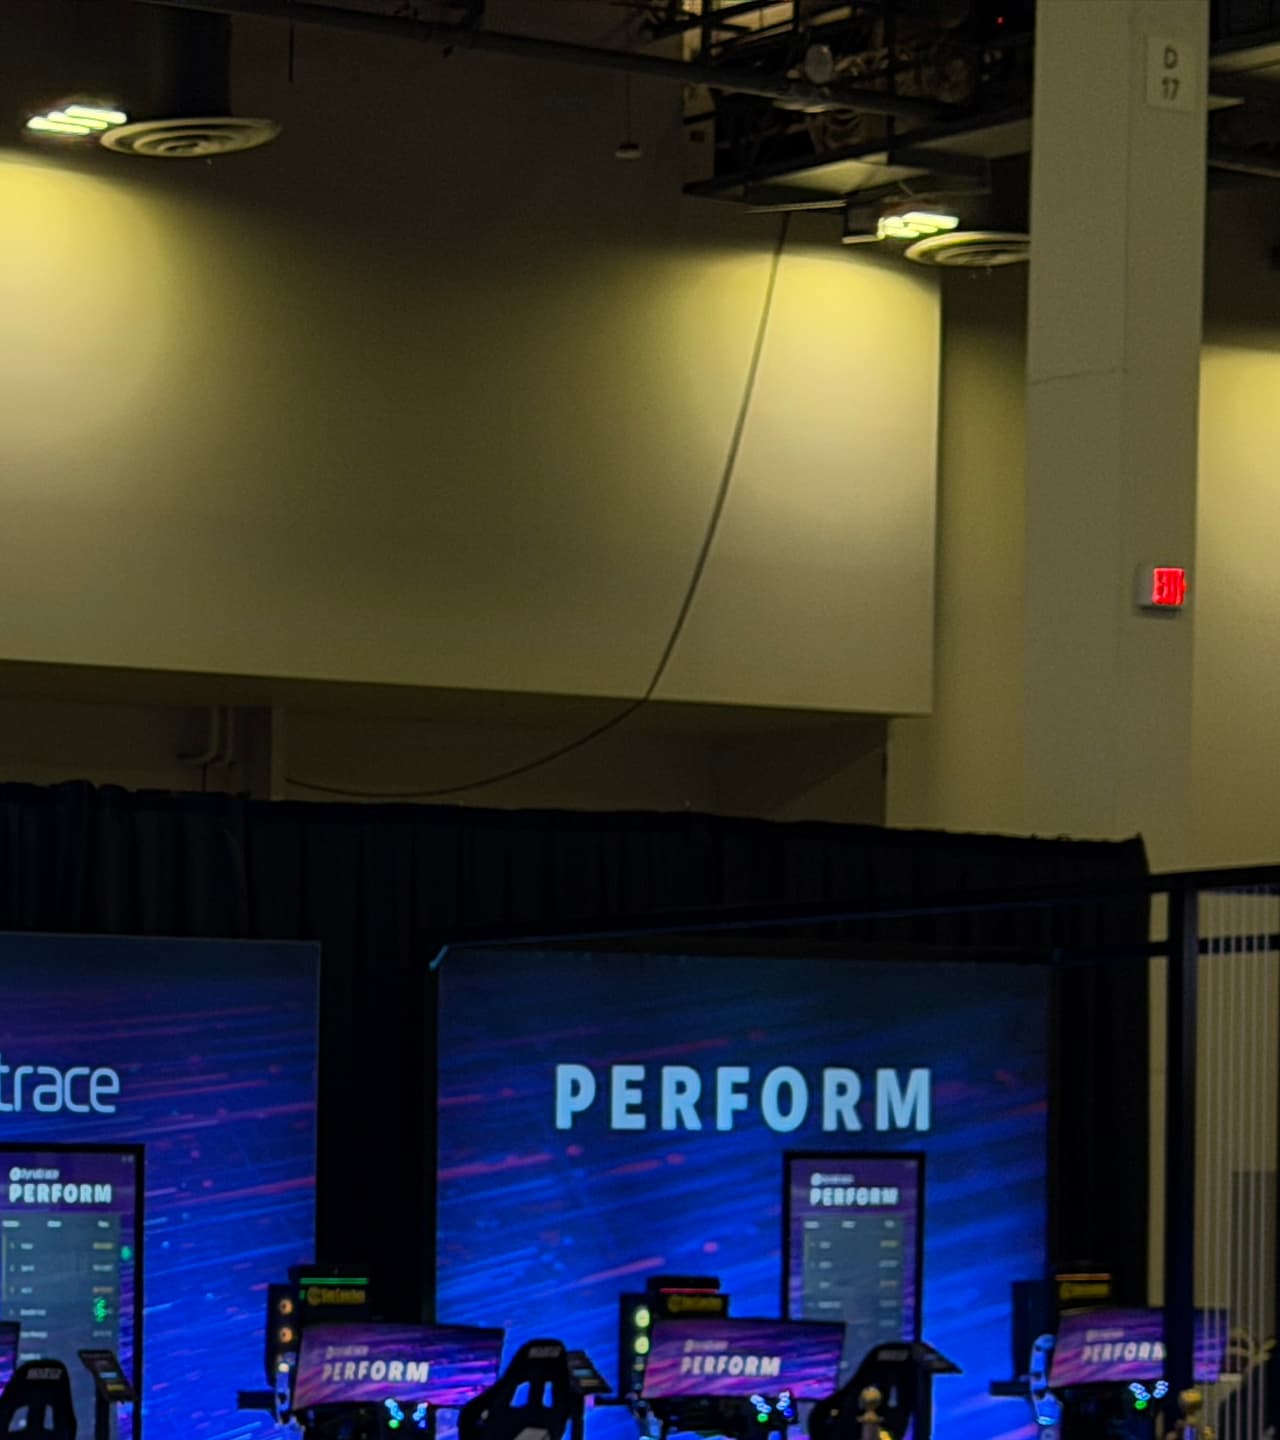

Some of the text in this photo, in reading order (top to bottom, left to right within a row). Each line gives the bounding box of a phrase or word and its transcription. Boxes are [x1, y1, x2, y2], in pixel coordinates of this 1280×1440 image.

[1164, 45, 1178, 70] D
[1161, 76, 1180, 101] 17
[555, 1063, 932, 1133] PERFORM
[9, 1183, 112, 1203] PERFORM
[810, 1187, 899, 1205] PERFORM
[321, 1360, 430, 1383] PERFORM
[680, 1355, 782, 1377] PERFORM
